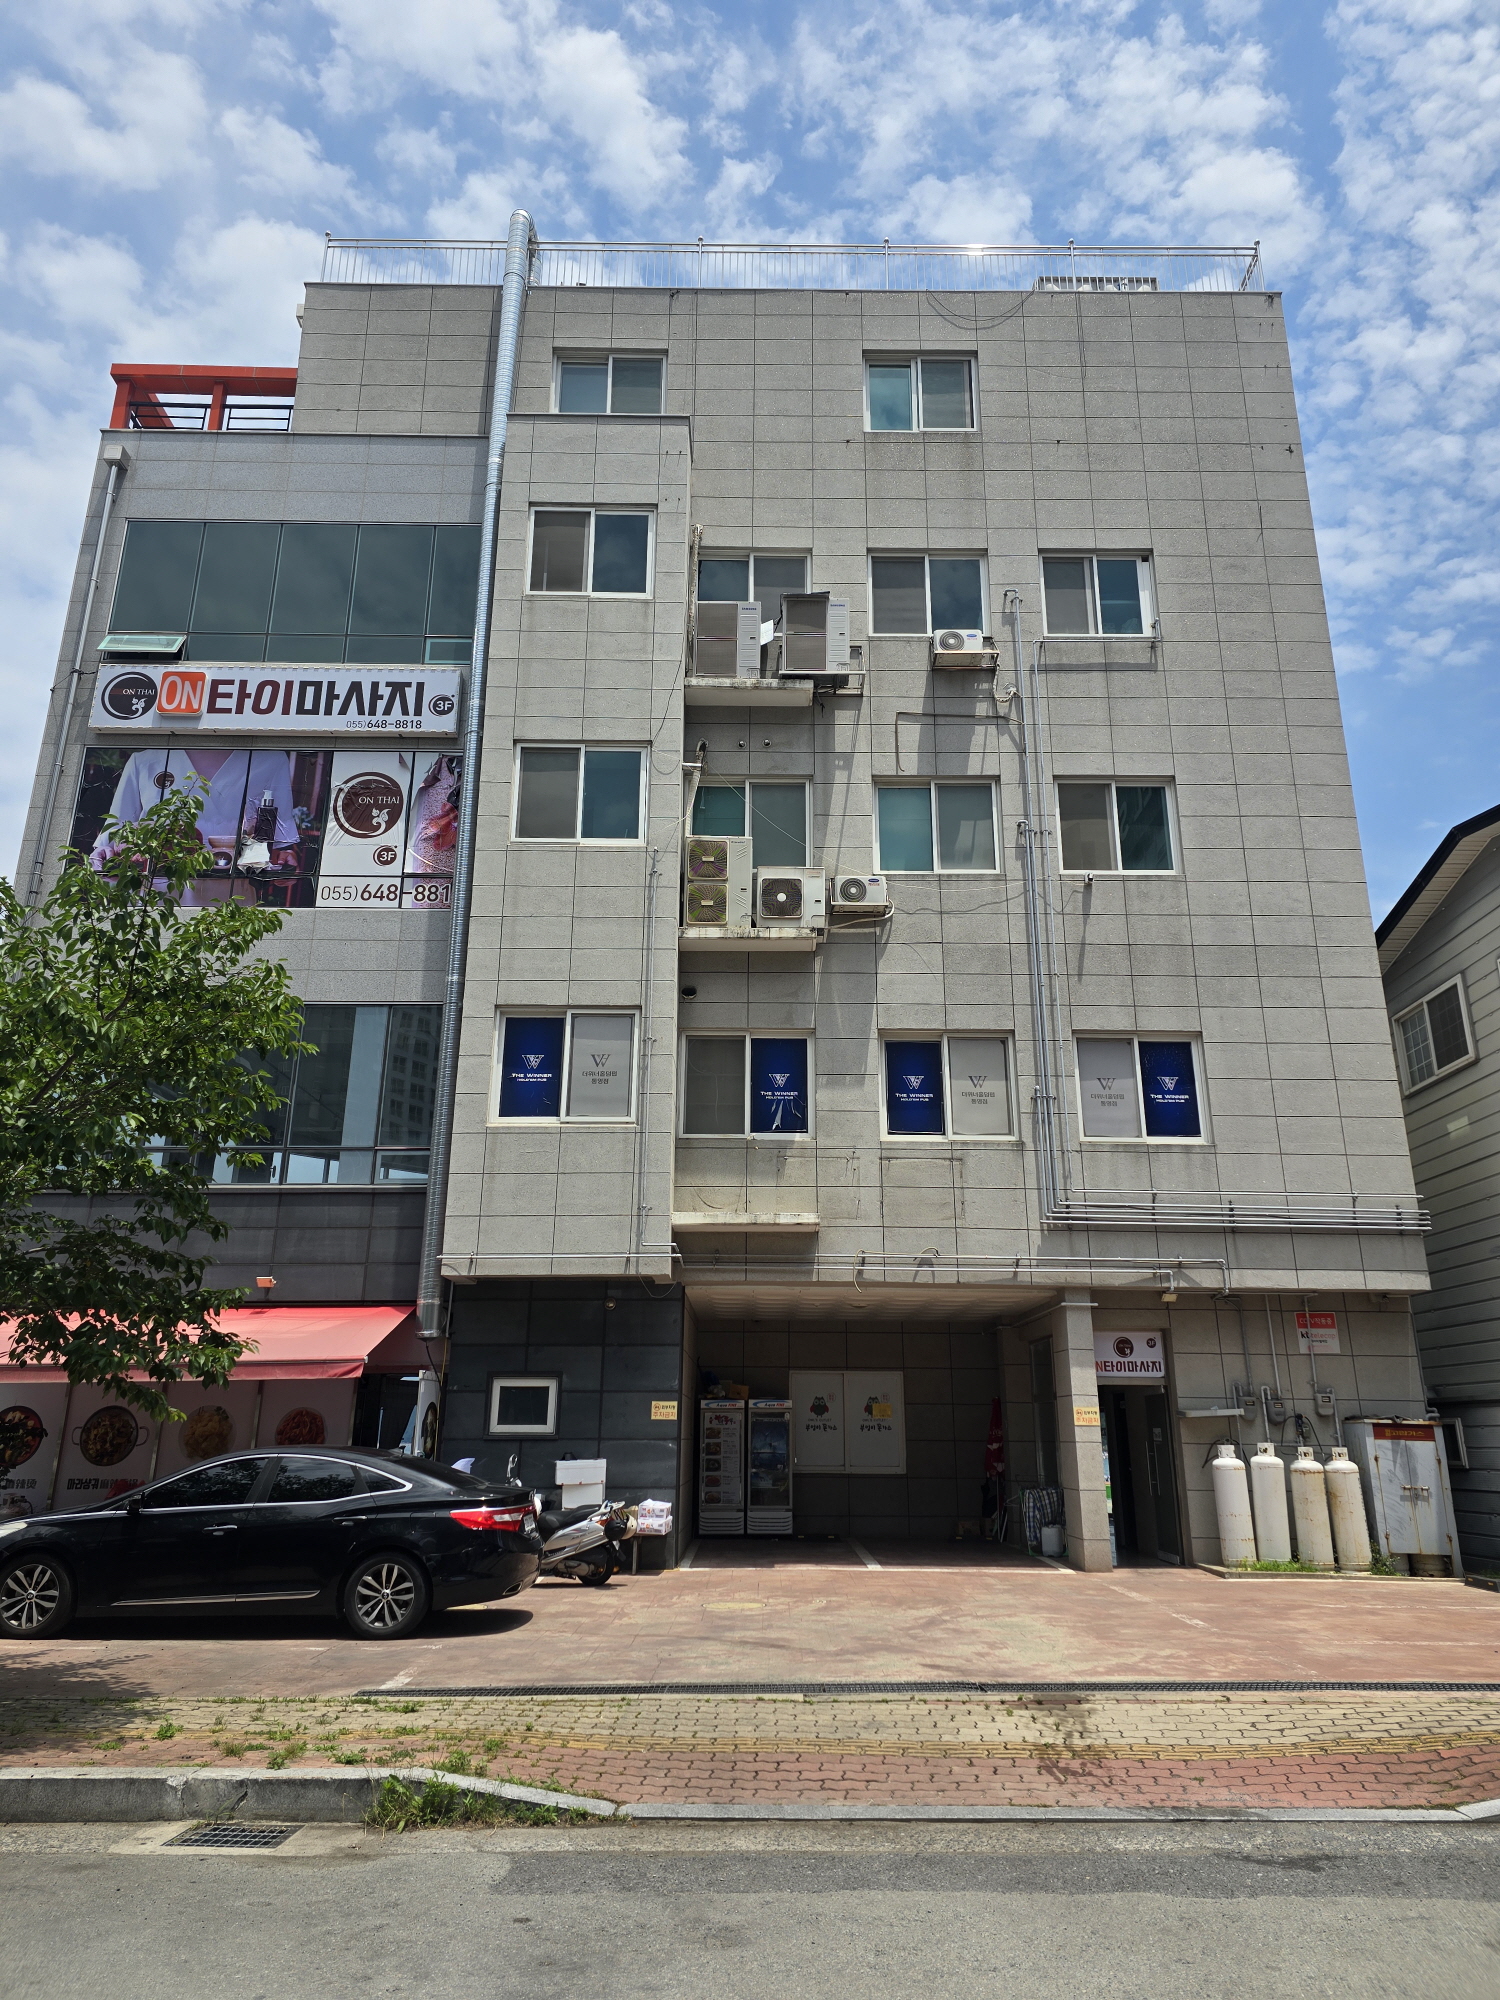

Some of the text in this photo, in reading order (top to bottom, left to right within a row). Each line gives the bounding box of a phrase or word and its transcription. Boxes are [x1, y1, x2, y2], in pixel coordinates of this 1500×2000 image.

[160, 675, 425, 716] ON 타이마사지
[435, 701, 453, 711] 3F
[346, 720, 422, 729] 055)648-8818
[358, 796, 400, 804] ON THAI
[379, 851, 396, 861] 3F
[321, 883, 451, 903] 055)648-881
